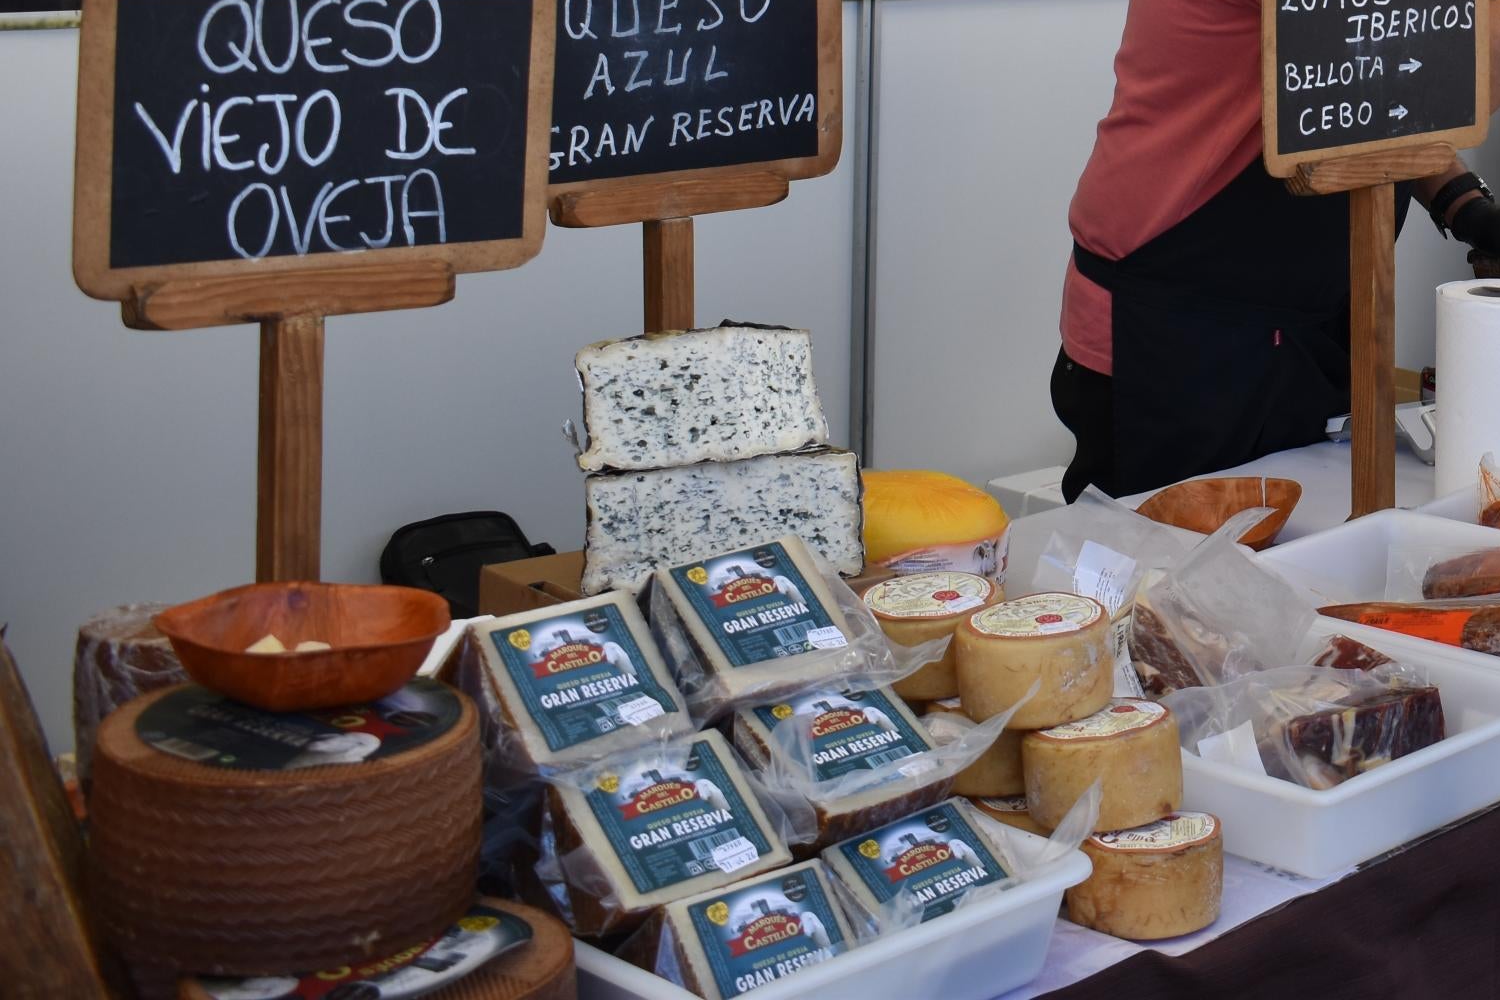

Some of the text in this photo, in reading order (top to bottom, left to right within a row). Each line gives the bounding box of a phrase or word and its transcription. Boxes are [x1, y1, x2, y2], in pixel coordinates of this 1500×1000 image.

[1345, 1, 1475, 43] IBERICOS
[584, 45, 730, 100] AZUL
[1284, 55, 1384, 92] BELLOTA
[385, 85, 477, 162] DE
[668, 92, 816, 149] RESERVA
[1299, 101, 1373, 135] CEBO
[227, 167, 447, 262] OVEJA
[724, 582, 773, 603] CASTILLO
[723, 617, 758, 634] GRAN
[760, 602, 809, 623] RESERVA
[547, 650, 601, 673] CASTILLO
[540, 688, 580, 709] GRAN
[580, 673, 639, 699] RESERVA
[812, 714, 864, 736] CASTILLO
[813, 729, 902, 765] GRAN RESERVA
[636, 787, 694, 814] CASTILLO
[630, 829, 671, 850] GRAN
[672, 808, 733, 837] RESERVA
[899, 849, 949, 876] CASTILLO
[938, 865, 989, 894] RESERVA
[743, 922, 798, 951] CASTILLO
[735, 968, 775, 993] GRAN
